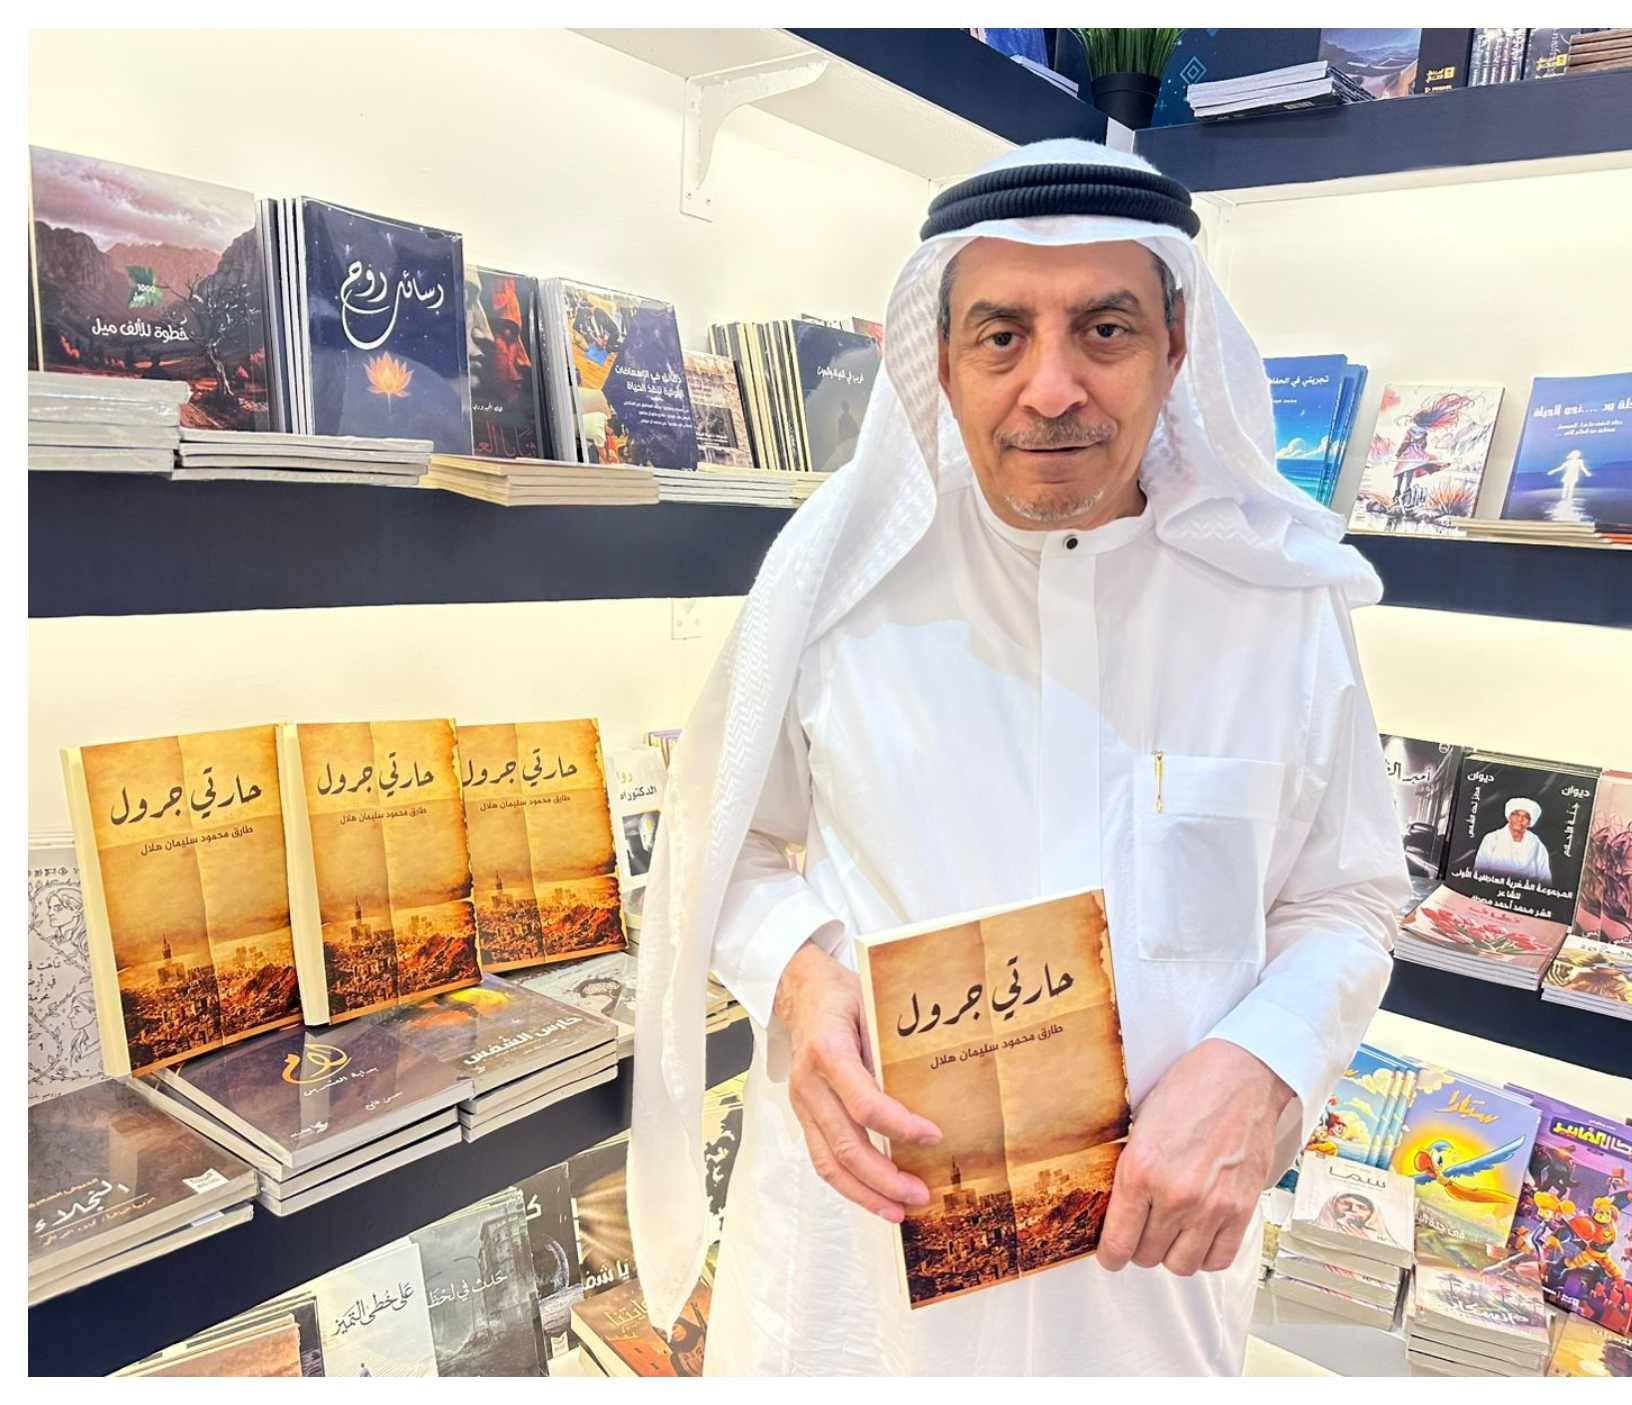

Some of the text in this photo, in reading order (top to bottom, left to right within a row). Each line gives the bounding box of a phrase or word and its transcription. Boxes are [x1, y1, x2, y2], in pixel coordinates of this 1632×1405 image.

[342, 268, 445, 350] رسائل
[91, 318, 118, 336] ميل
[120, 318, 151, 337] للألف
[1290, 376, 1301, 388] في
[317, 752, 434, 797] حارتي جرول
[461, 748, 578, 787] حارتي جرول
[1467, 771, 1495, 783] ديوان
[110, 766, 262, 825] حارتي جرول
[529, 796, 551, 805] محمود
[1561, 785, 1591, 798] ديوان
[480, 801, 498, 812] هلال
[500, 799, 526, 810] سليمان
[340, 807, 427, 825] طارق محمود سليمان هلال
[141, 826, 254, 856] طارق محمود سليمان هلال
[897, 955, 1075, 1037] حارتي جرول
[463, 1015, 583, 1065] حارس الشمس
[930, 1024, 1064, 1070] طارق محمود سليمان هلال
[457, 1279, 471, 1299] في
[332, 1282, 414, 1336] على خطى التميز
